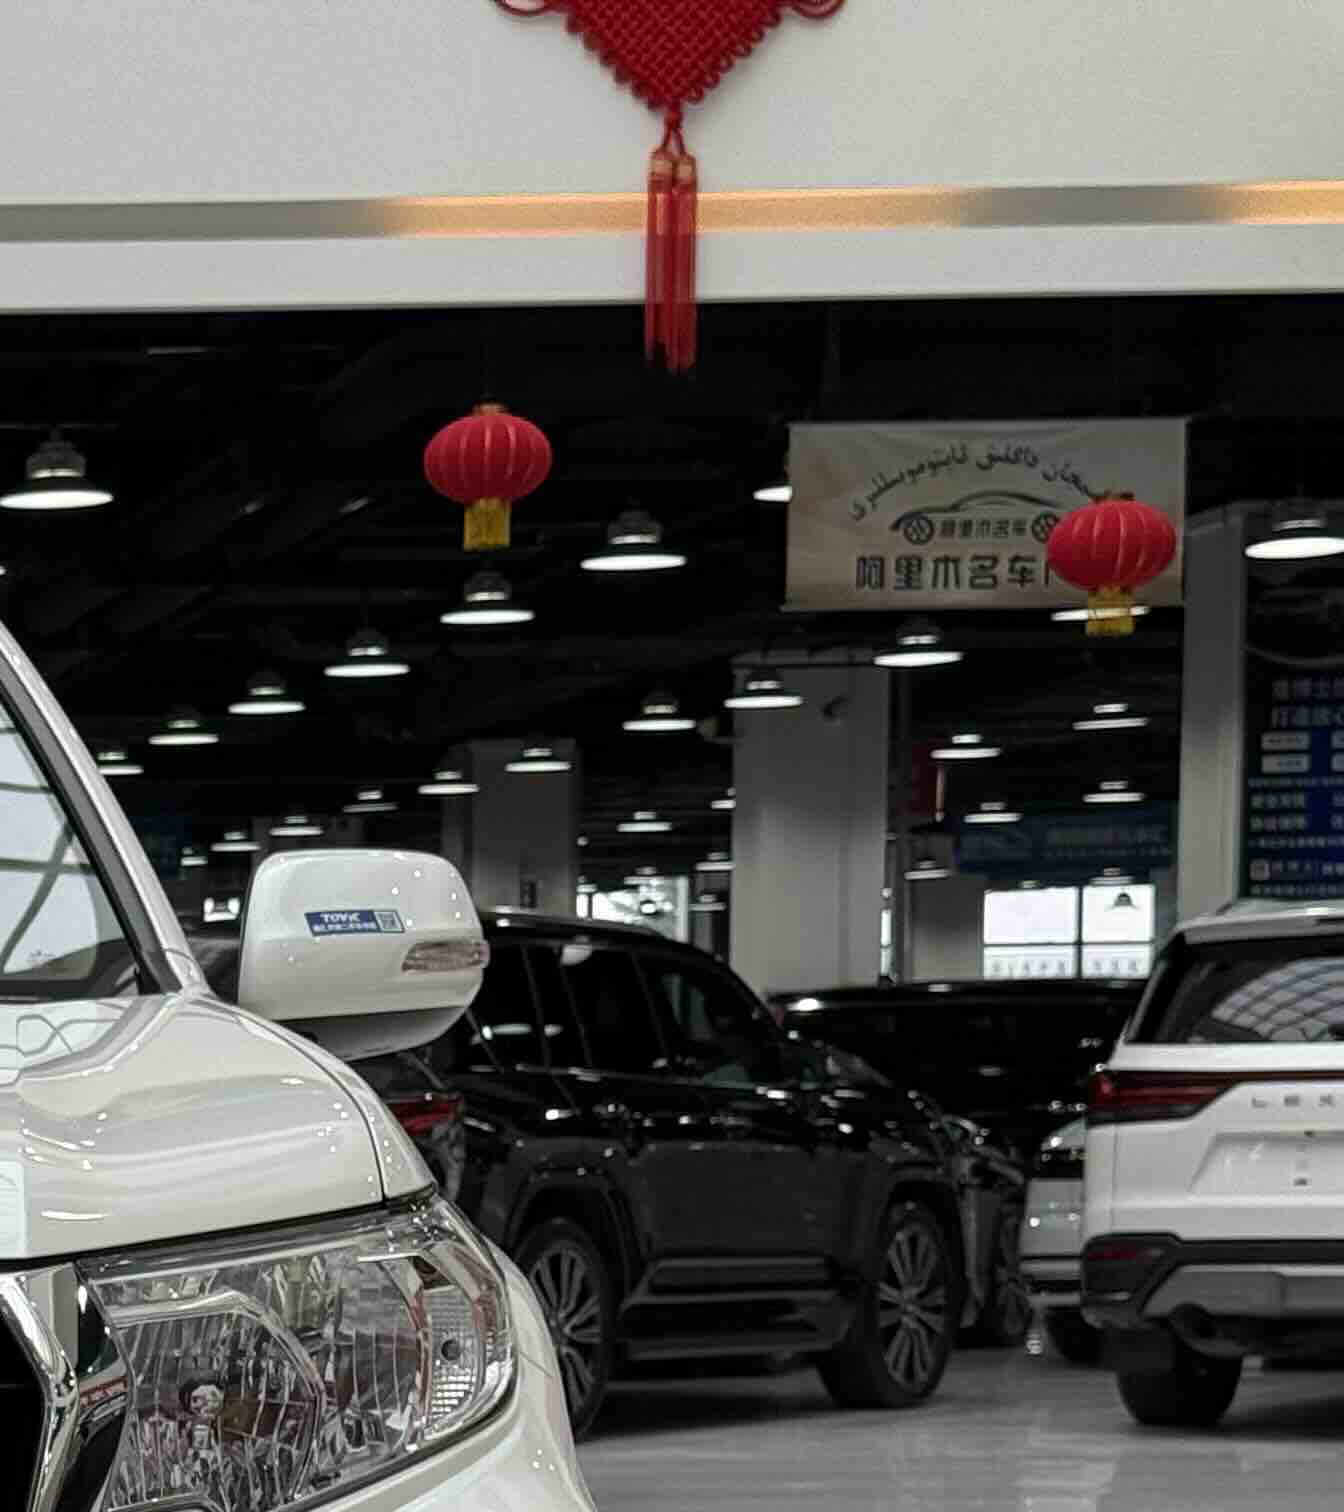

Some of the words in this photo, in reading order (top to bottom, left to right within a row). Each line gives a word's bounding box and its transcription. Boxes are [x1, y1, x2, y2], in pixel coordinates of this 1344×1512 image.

[855, 553, 1050, 591] 阿里木名车
